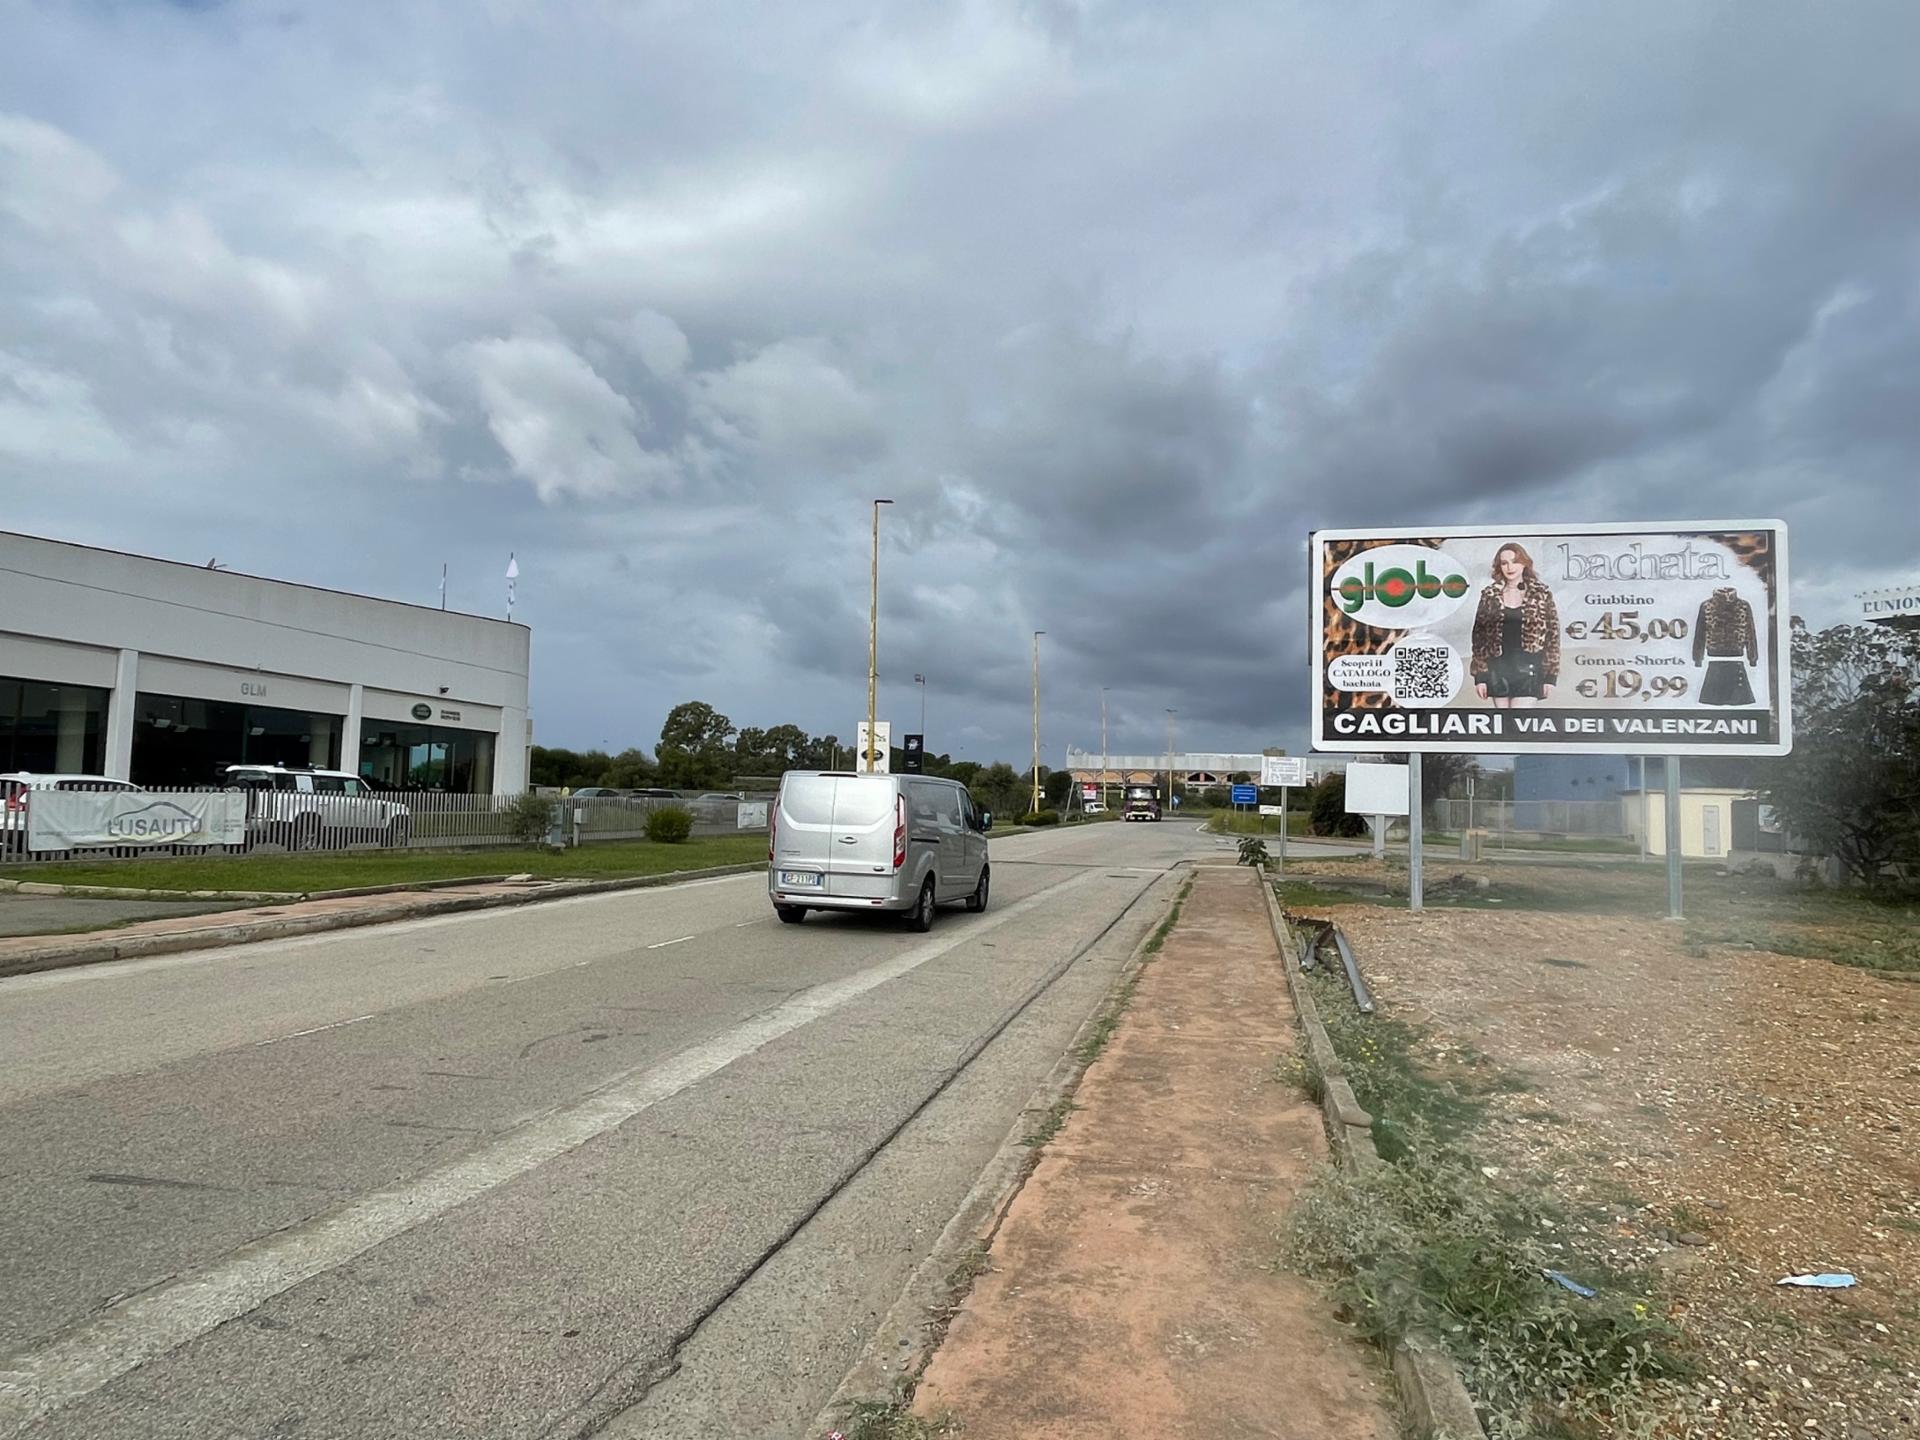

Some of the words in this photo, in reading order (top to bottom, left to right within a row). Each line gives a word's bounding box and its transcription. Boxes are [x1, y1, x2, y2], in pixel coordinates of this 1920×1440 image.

[1557, 542, 1731, 581] bachata
[1339, 560, 1468, 613] globo
[1584, 593, 1655, 605] Giubbino
[1341, 660, 1373, 669] Scopri
[1333, 669, 1391, 677] CATALOGO
[241, 682, 267, 697] GLM
[1333, 713, 1503, 734] CAGLIARI
[1514, 717, 1557, 733] VIA
[1564, 718, 1605, 733] DEI
[1612, 718, 1758, 735] VALENZANI
